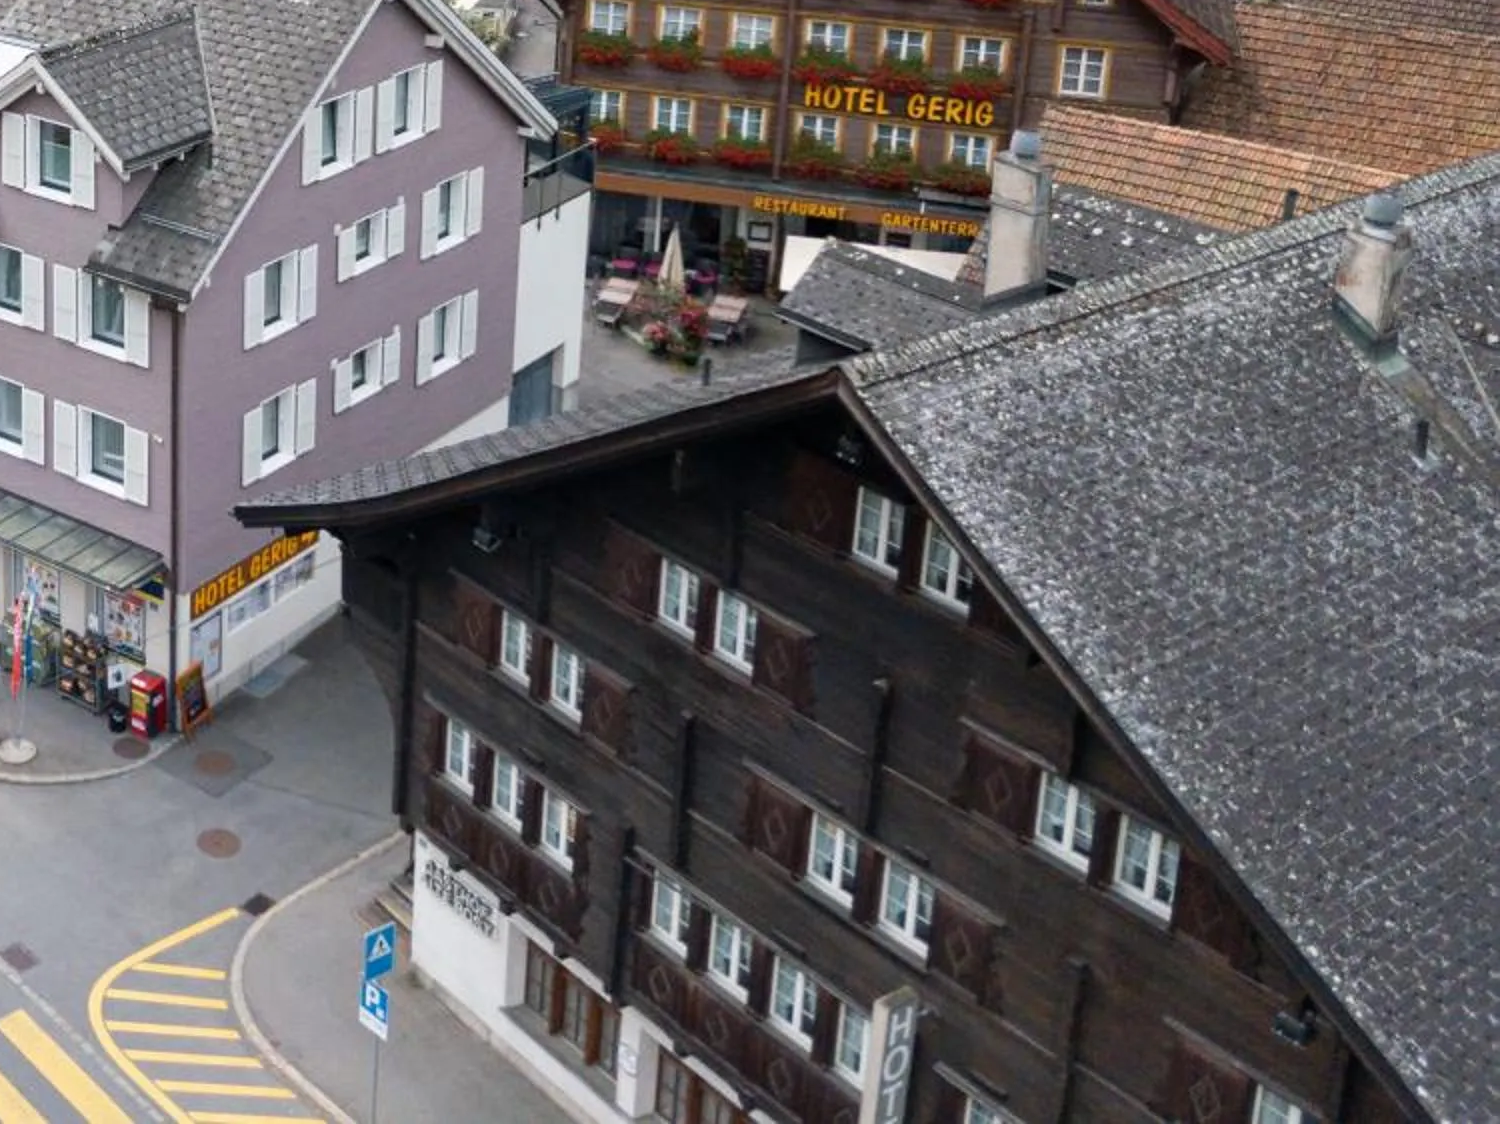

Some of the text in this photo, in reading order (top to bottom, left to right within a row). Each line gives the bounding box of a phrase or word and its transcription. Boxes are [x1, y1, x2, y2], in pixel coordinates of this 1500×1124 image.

[804, 83, 995, 127] HOTEL GERIG
[753, 194, 848, 221] RESTAURANT
[194, 538, 299, 615] HOTEL GERIG
[883, 1005, 914, 1124] HOT
